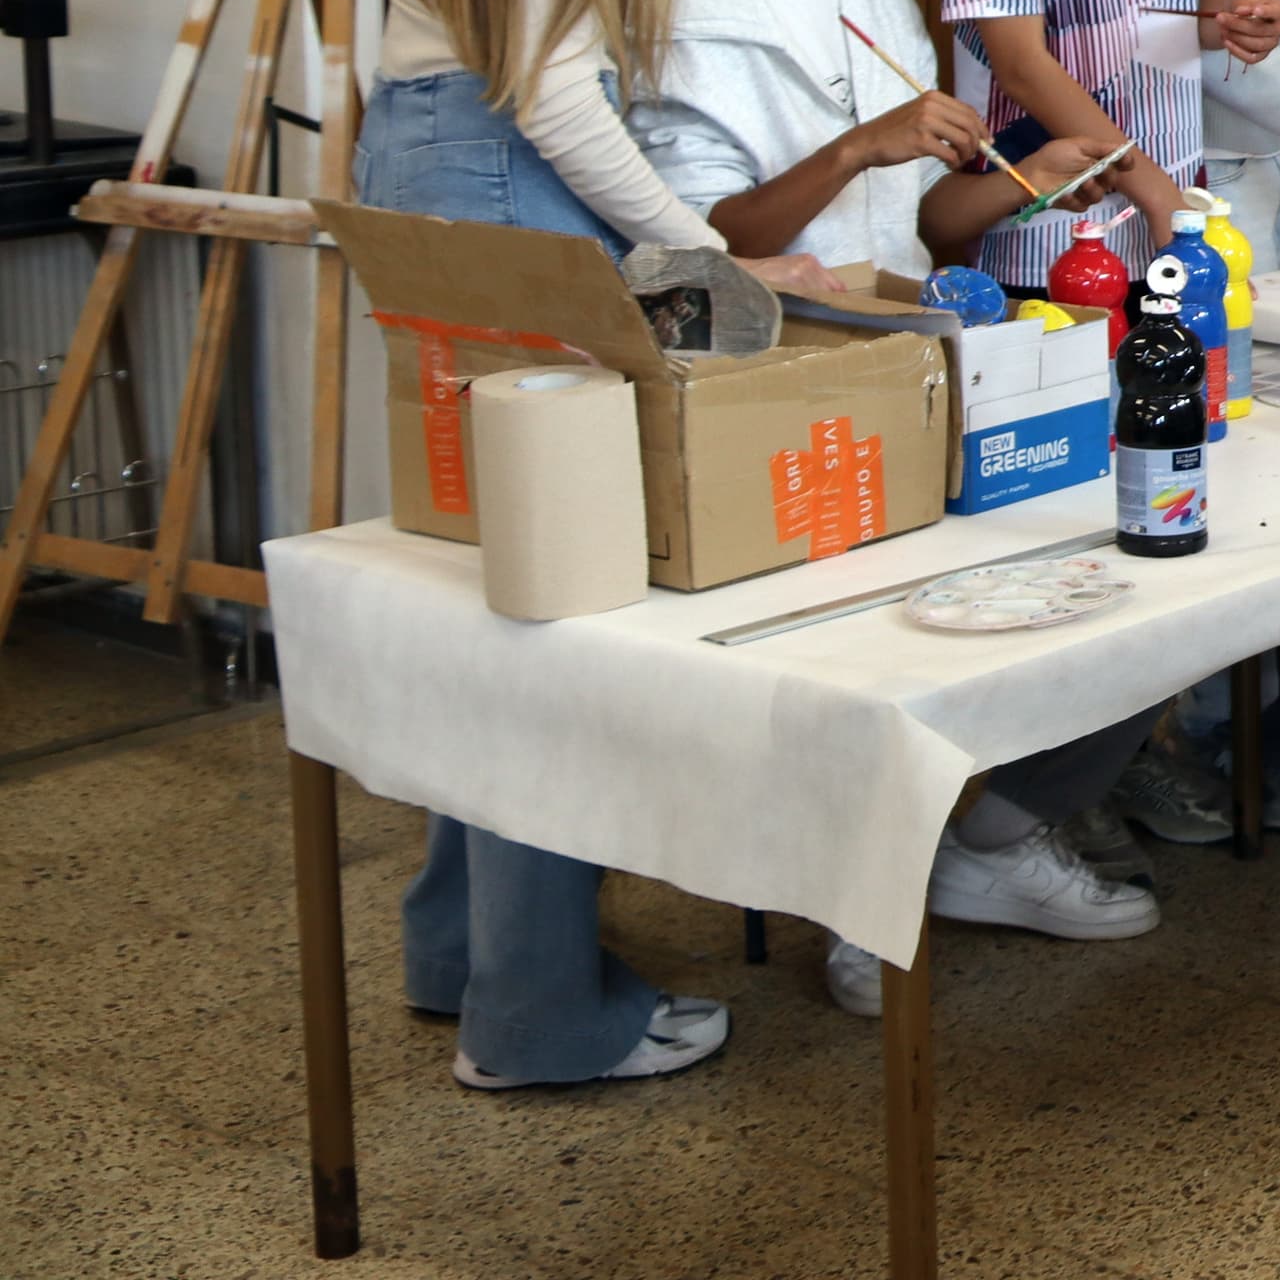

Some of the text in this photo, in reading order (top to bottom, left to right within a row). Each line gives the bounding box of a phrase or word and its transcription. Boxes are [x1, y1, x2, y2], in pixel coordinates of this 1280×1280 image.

[980, 436, 1070, 477] GREENING
[983, 435, 1012, 454] NEW
[856, 469, 874, 541] GRUPO
